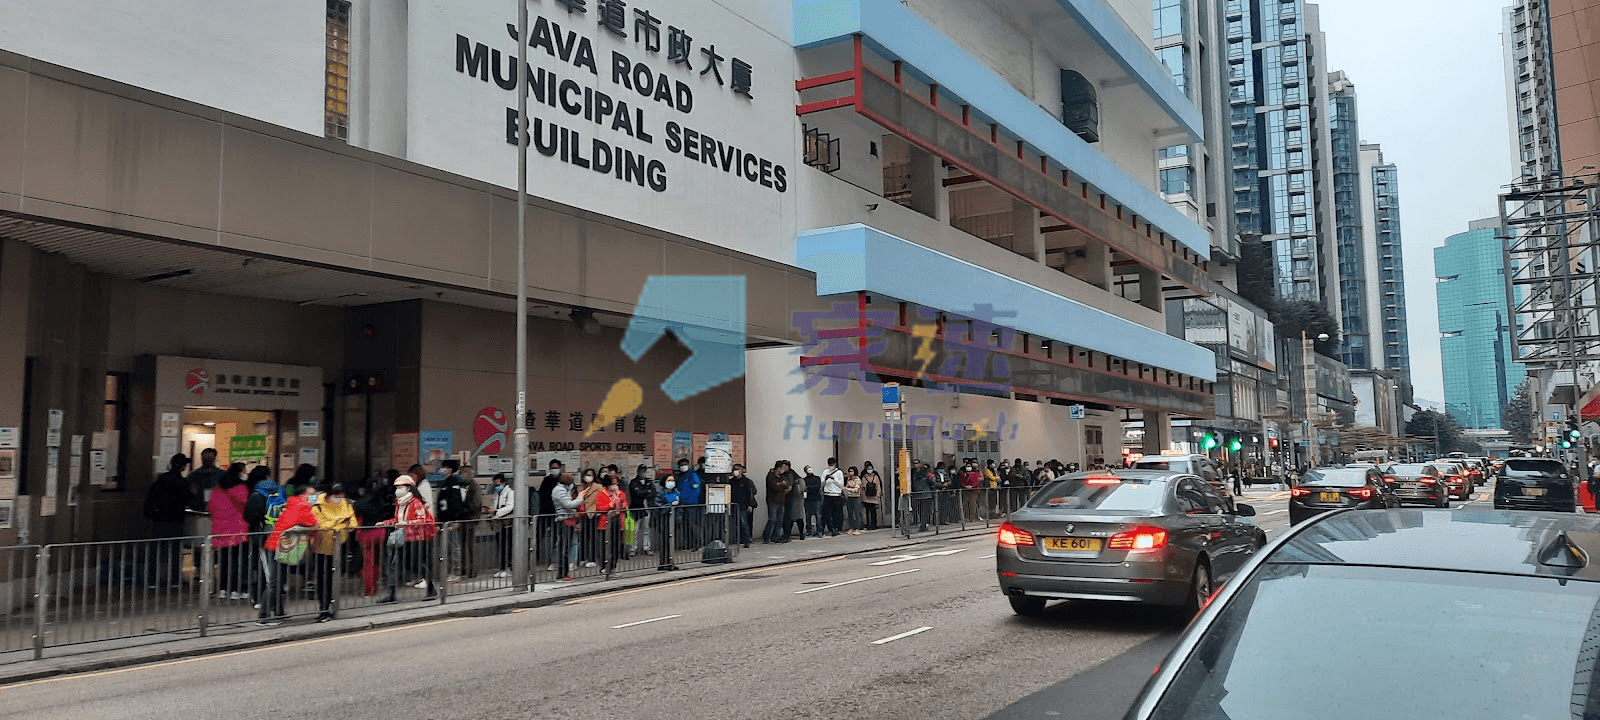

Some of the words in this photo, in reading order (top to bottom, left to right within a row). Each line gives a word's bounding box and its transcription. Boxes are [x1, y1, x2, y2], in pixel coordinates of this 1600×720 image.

[553, 0, 753, 99] 道市政大廈
[612, 51, 693, 114] ROAD
[455, 33, 654, 144] MUNICIPAL
[664, 120, 788, 193] SERVICES
[506, 107, 668, 192] BUILDING
[548, 441, 575, 452] ROAD
[579, 441, 613, 452] SPORTS
[615, 442, 647, 452] CENTRE
[1052, 538, 1068, 549] KE
[1071, 538, 1091, 549] 601
